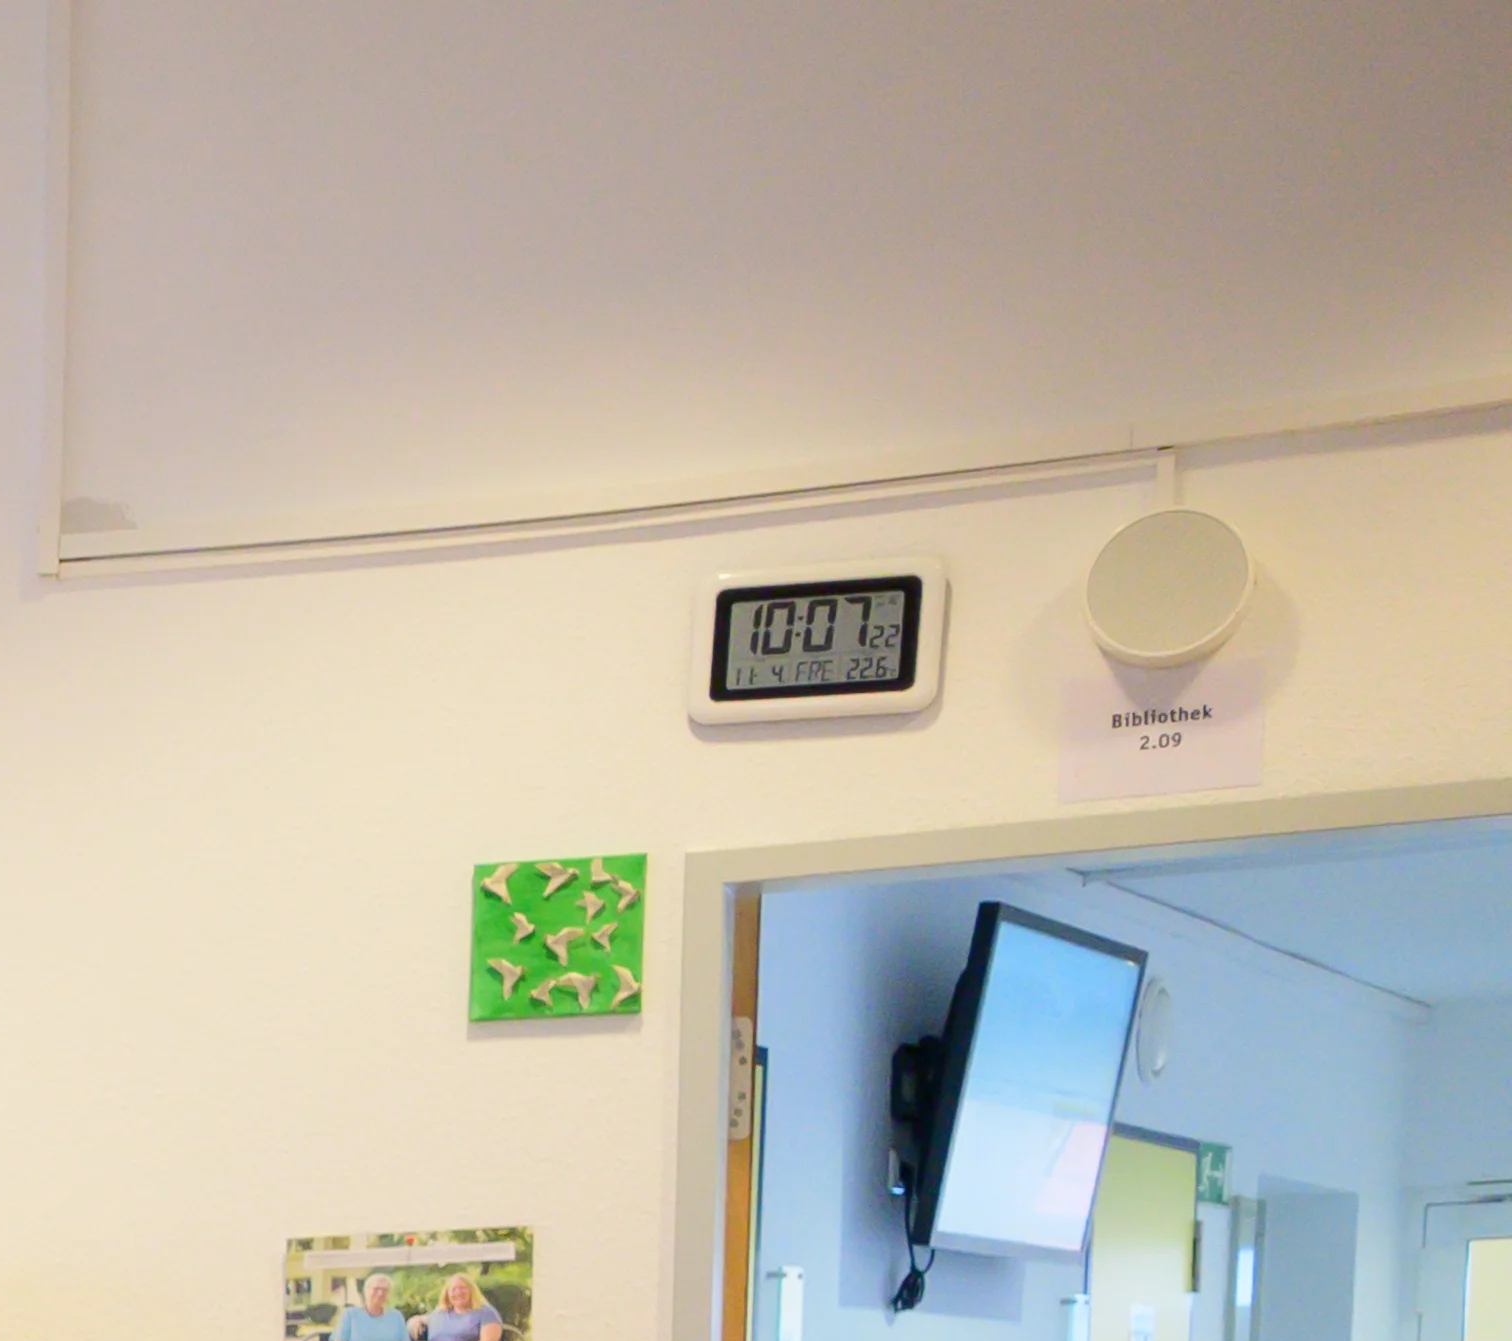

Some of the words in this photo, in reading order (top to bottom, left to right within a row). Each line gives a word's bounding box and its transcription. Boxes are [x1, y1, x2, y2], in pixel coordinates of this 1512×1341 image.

[751, 596, 872, 655] 10:07
[869, 624, 900, 648] 22
[1111, 704, 1214, 729] Bibliothek
[1139, 732, 1182, 751] 2.09
